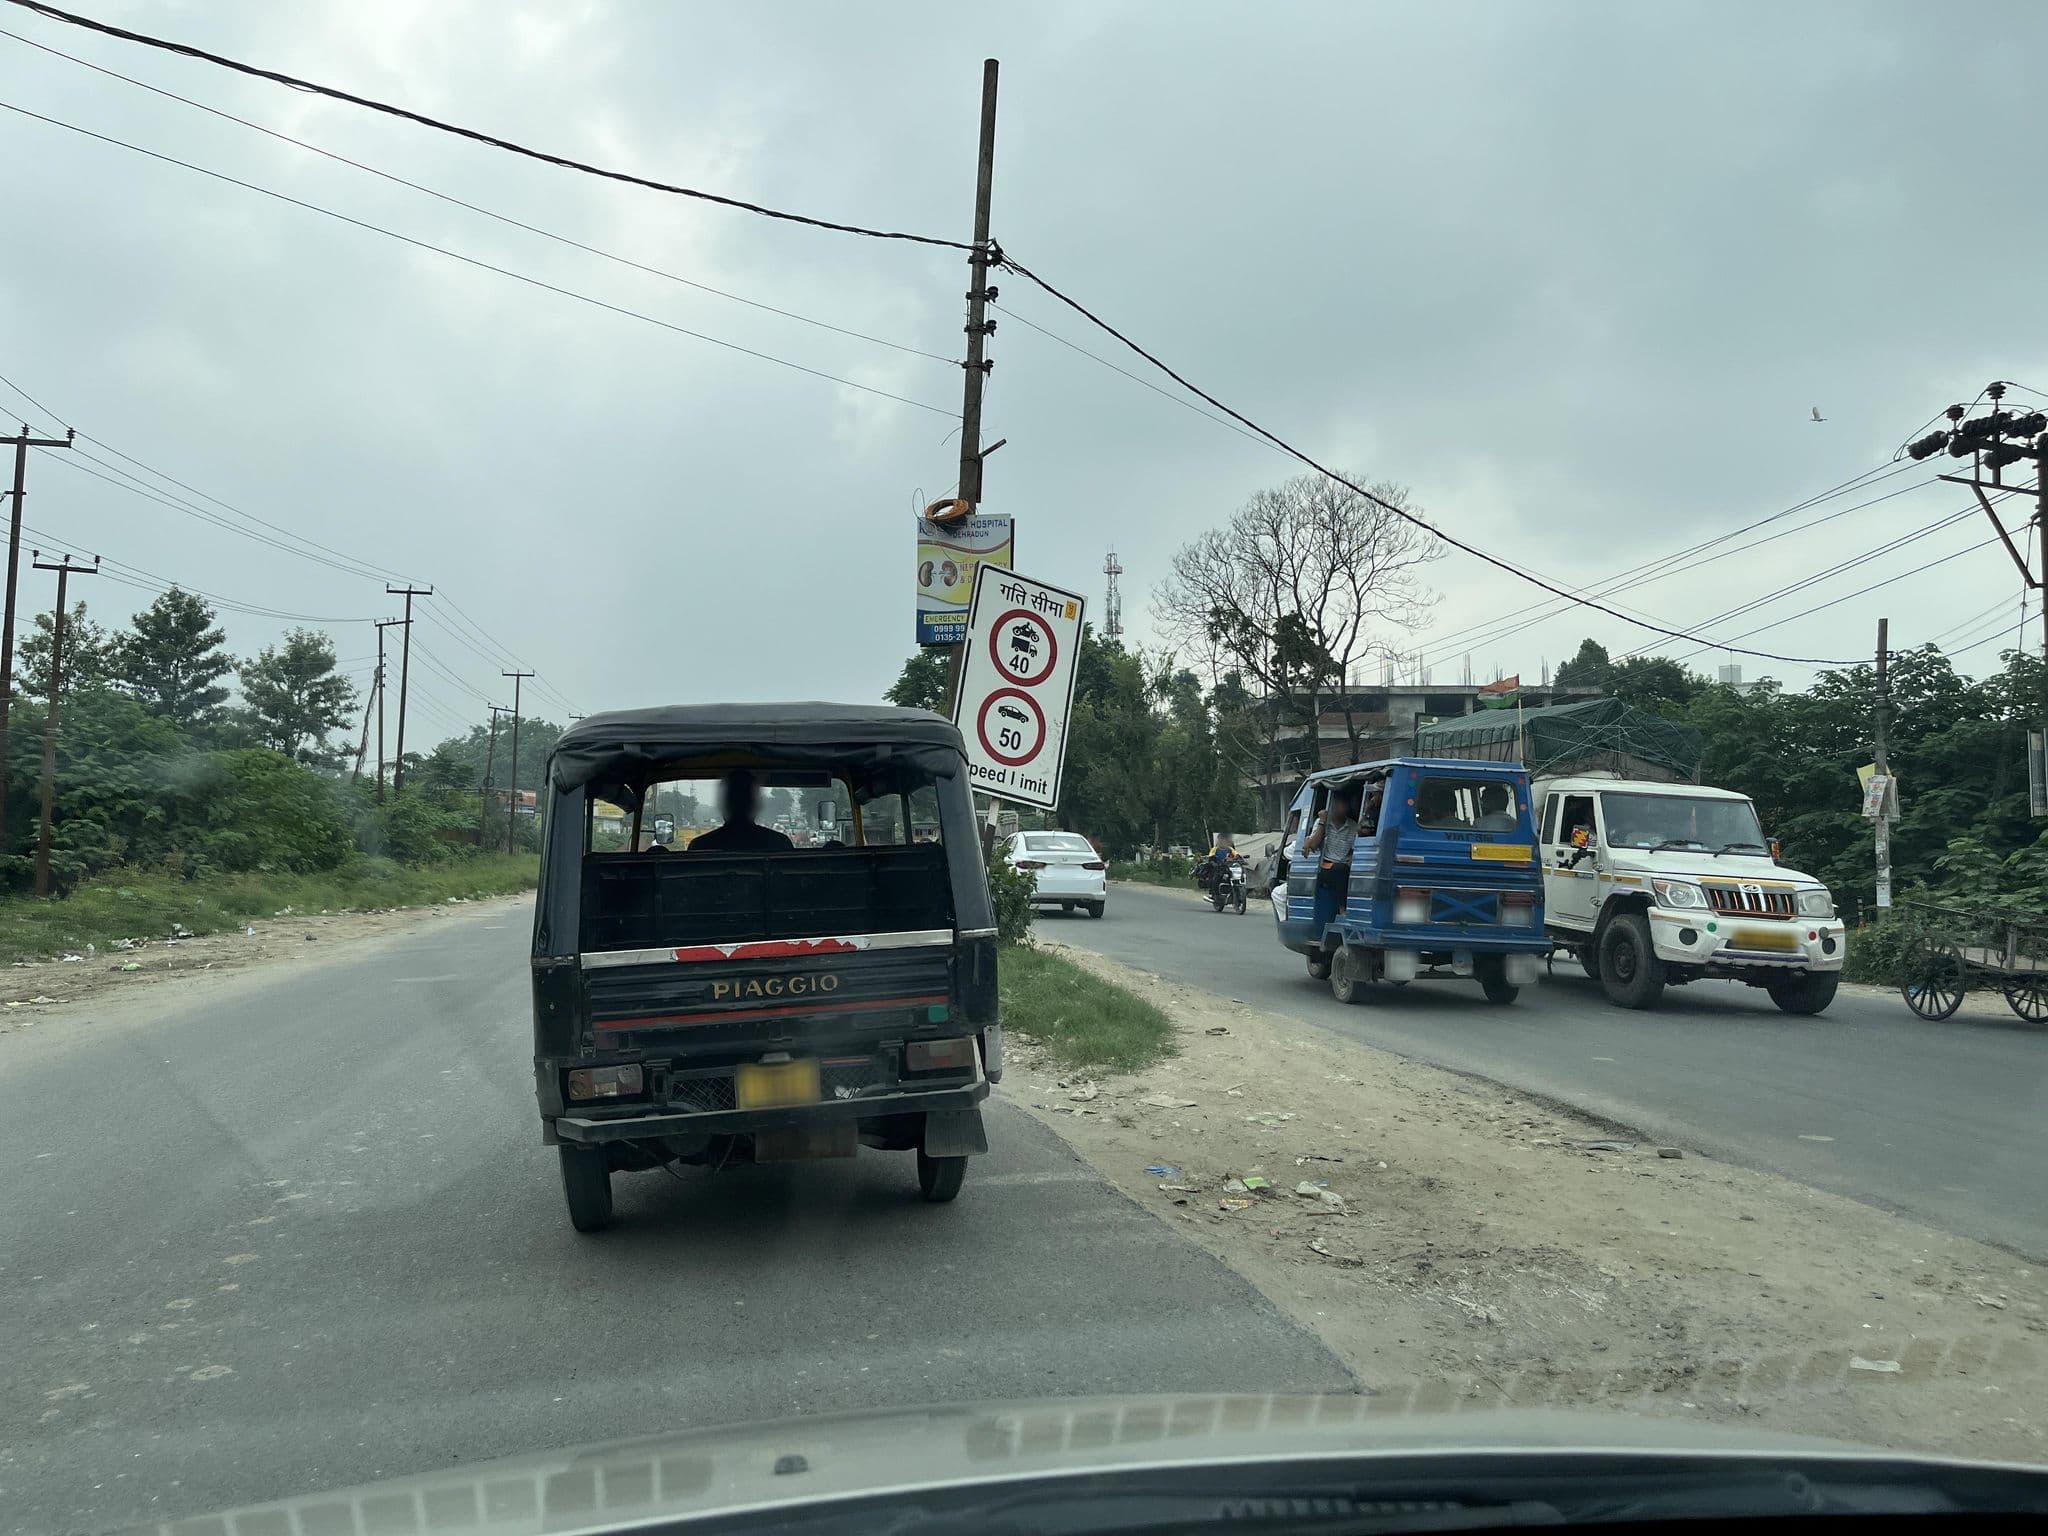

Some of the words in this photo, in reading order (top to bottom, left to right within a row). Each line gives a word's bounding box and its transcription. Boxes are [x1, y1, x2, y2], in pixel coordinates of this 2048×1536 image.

[970, 519, 1008, 529] HOSPITAL
[952, 530, 989, 539] DEHRADUN
[1000, 583, 1027, 606] गति
[1031, 591, 1065, 618] सीमा
[925, 615, 964, 623] EMERGENCY
[1009, 654, 1029, 674] 40
[999, 727, 1021, 750] 50
[969, 763, 1006, 784] peed
[712, 974, 838, 1000] PIAGGIO
